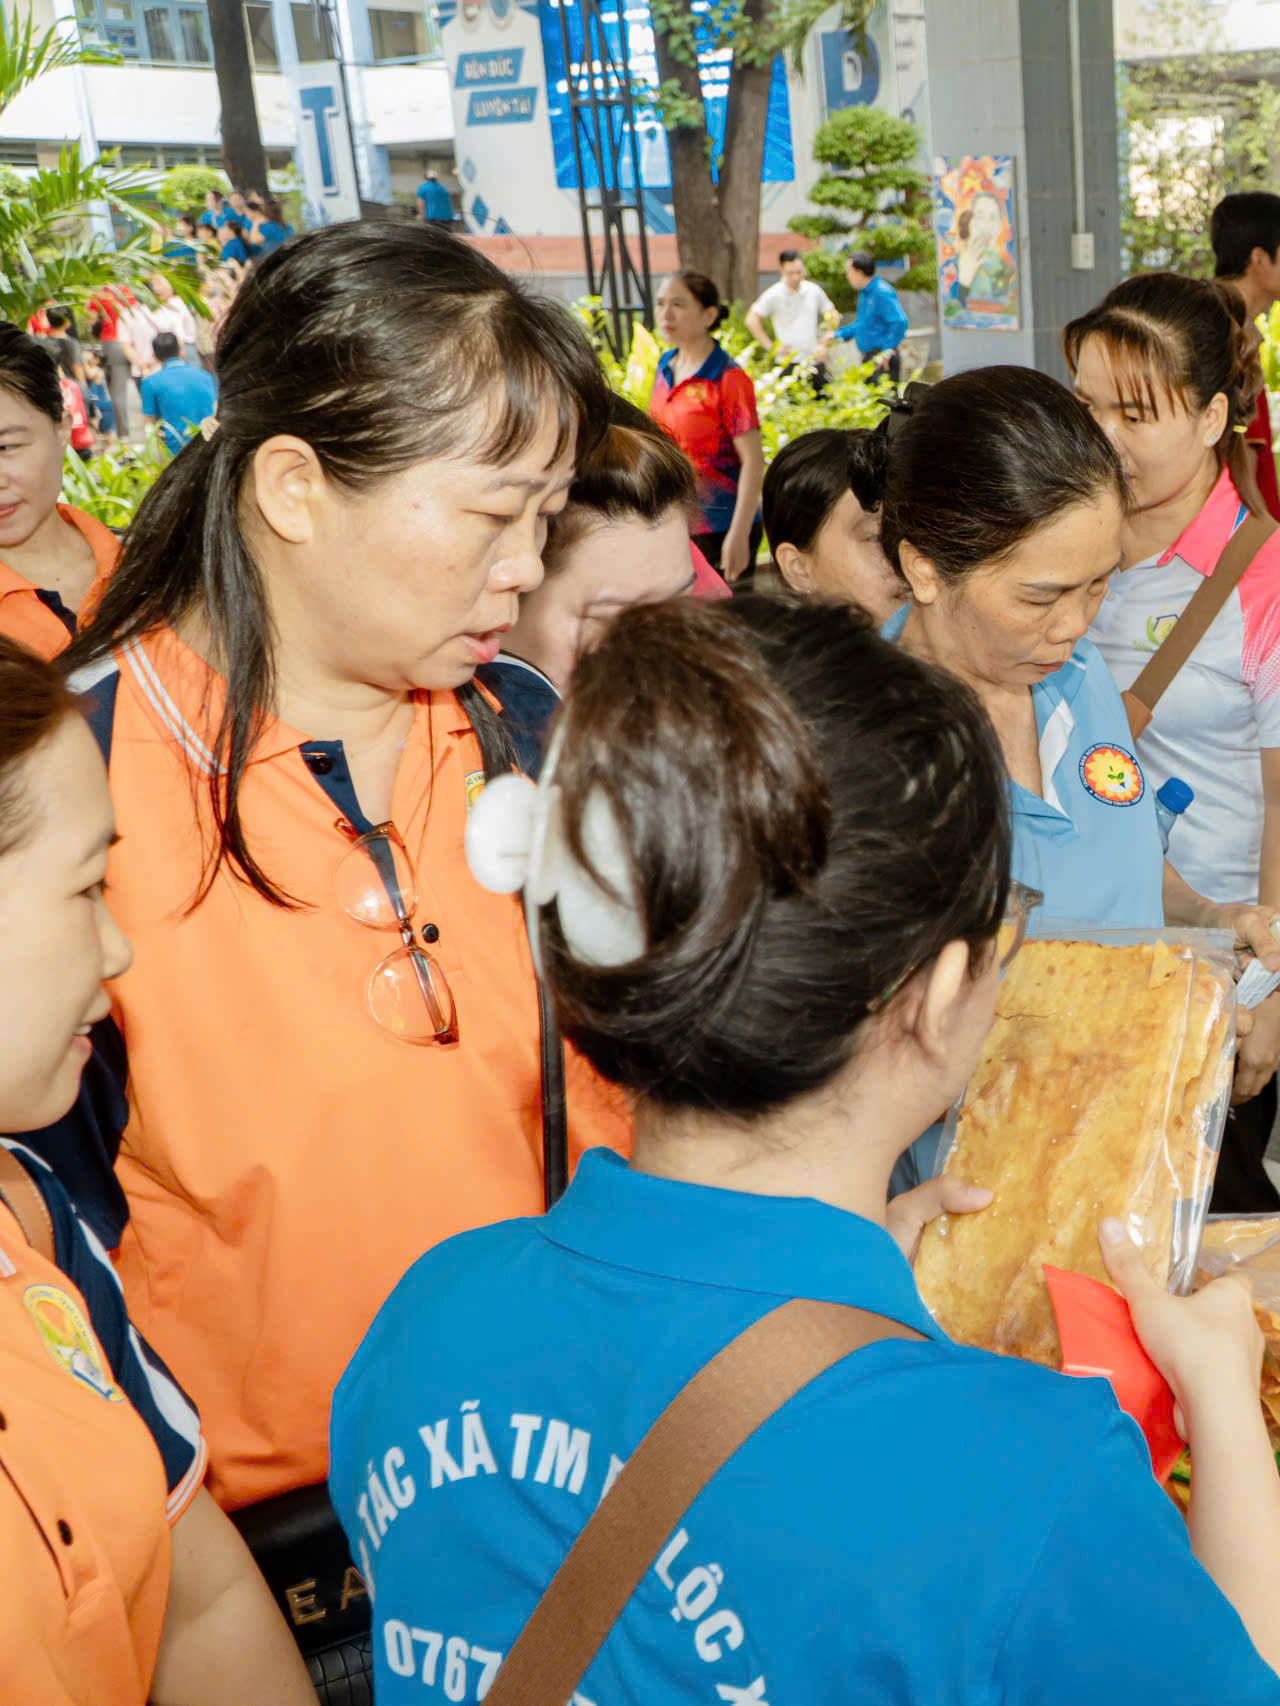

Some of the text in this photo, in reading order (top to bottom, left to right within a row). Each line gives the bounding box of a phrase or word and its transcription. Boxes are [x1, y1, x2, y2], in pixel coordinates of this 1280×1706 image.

[357, 1446, 416, 1551] TÁC
[418, 1399, 498, 1489] XÃ
[510, 1413, 591, 1495] TM
[654, 1527, 744, 1663] LỘC
